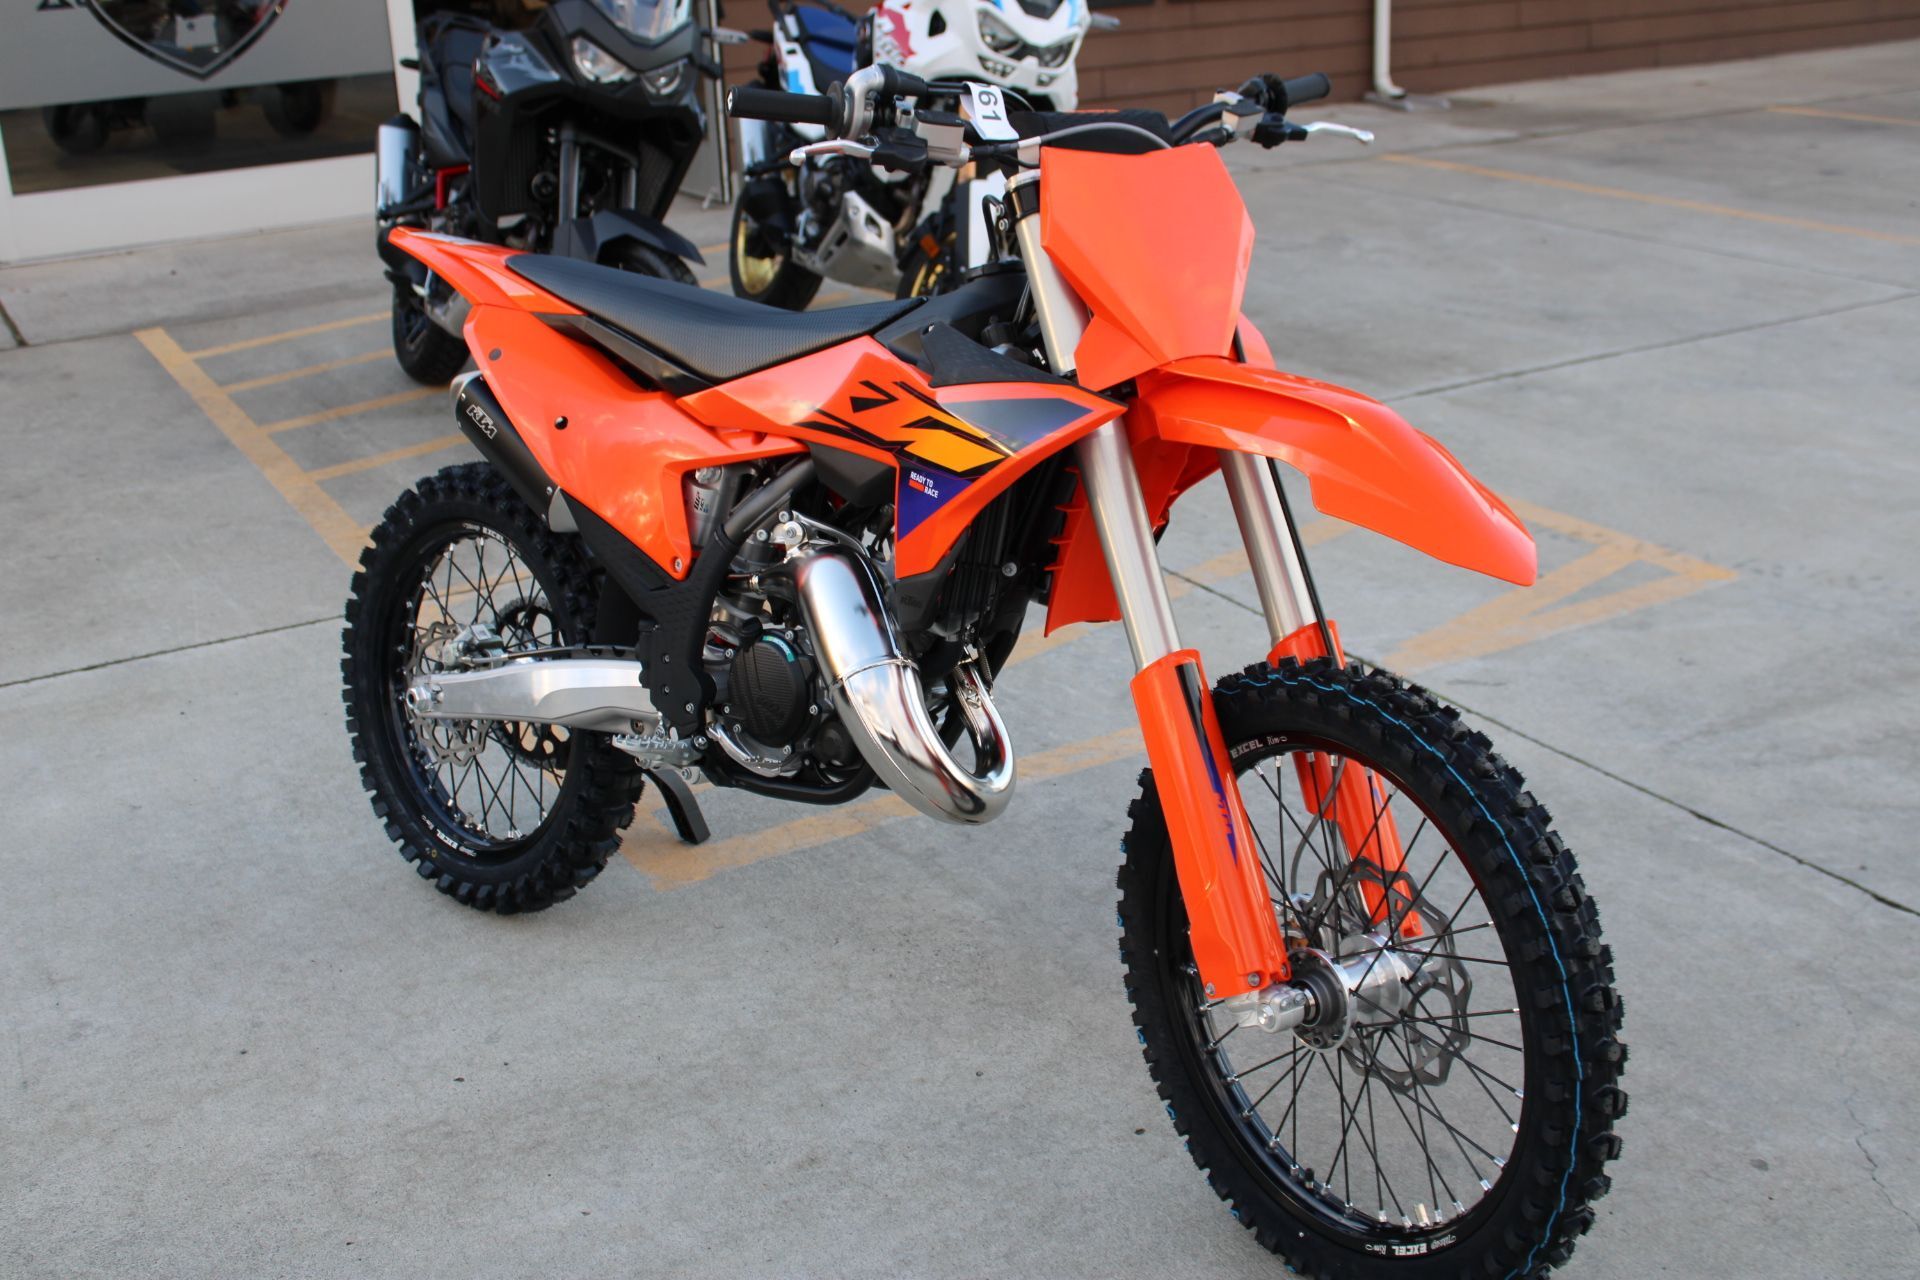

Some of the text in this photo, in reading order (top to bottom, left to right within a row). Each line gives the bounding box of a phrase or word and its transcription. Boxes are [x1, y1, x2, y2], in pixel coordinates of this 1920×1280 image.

[466, 404, 498, 440] KTM
[910, 471, 934, 488] READY TO
[924, 486, 939, 499] RACE
[1230, 739, 1263, 759] EXCEL
[1391, 1242, 1428, 1256] EXCEL
